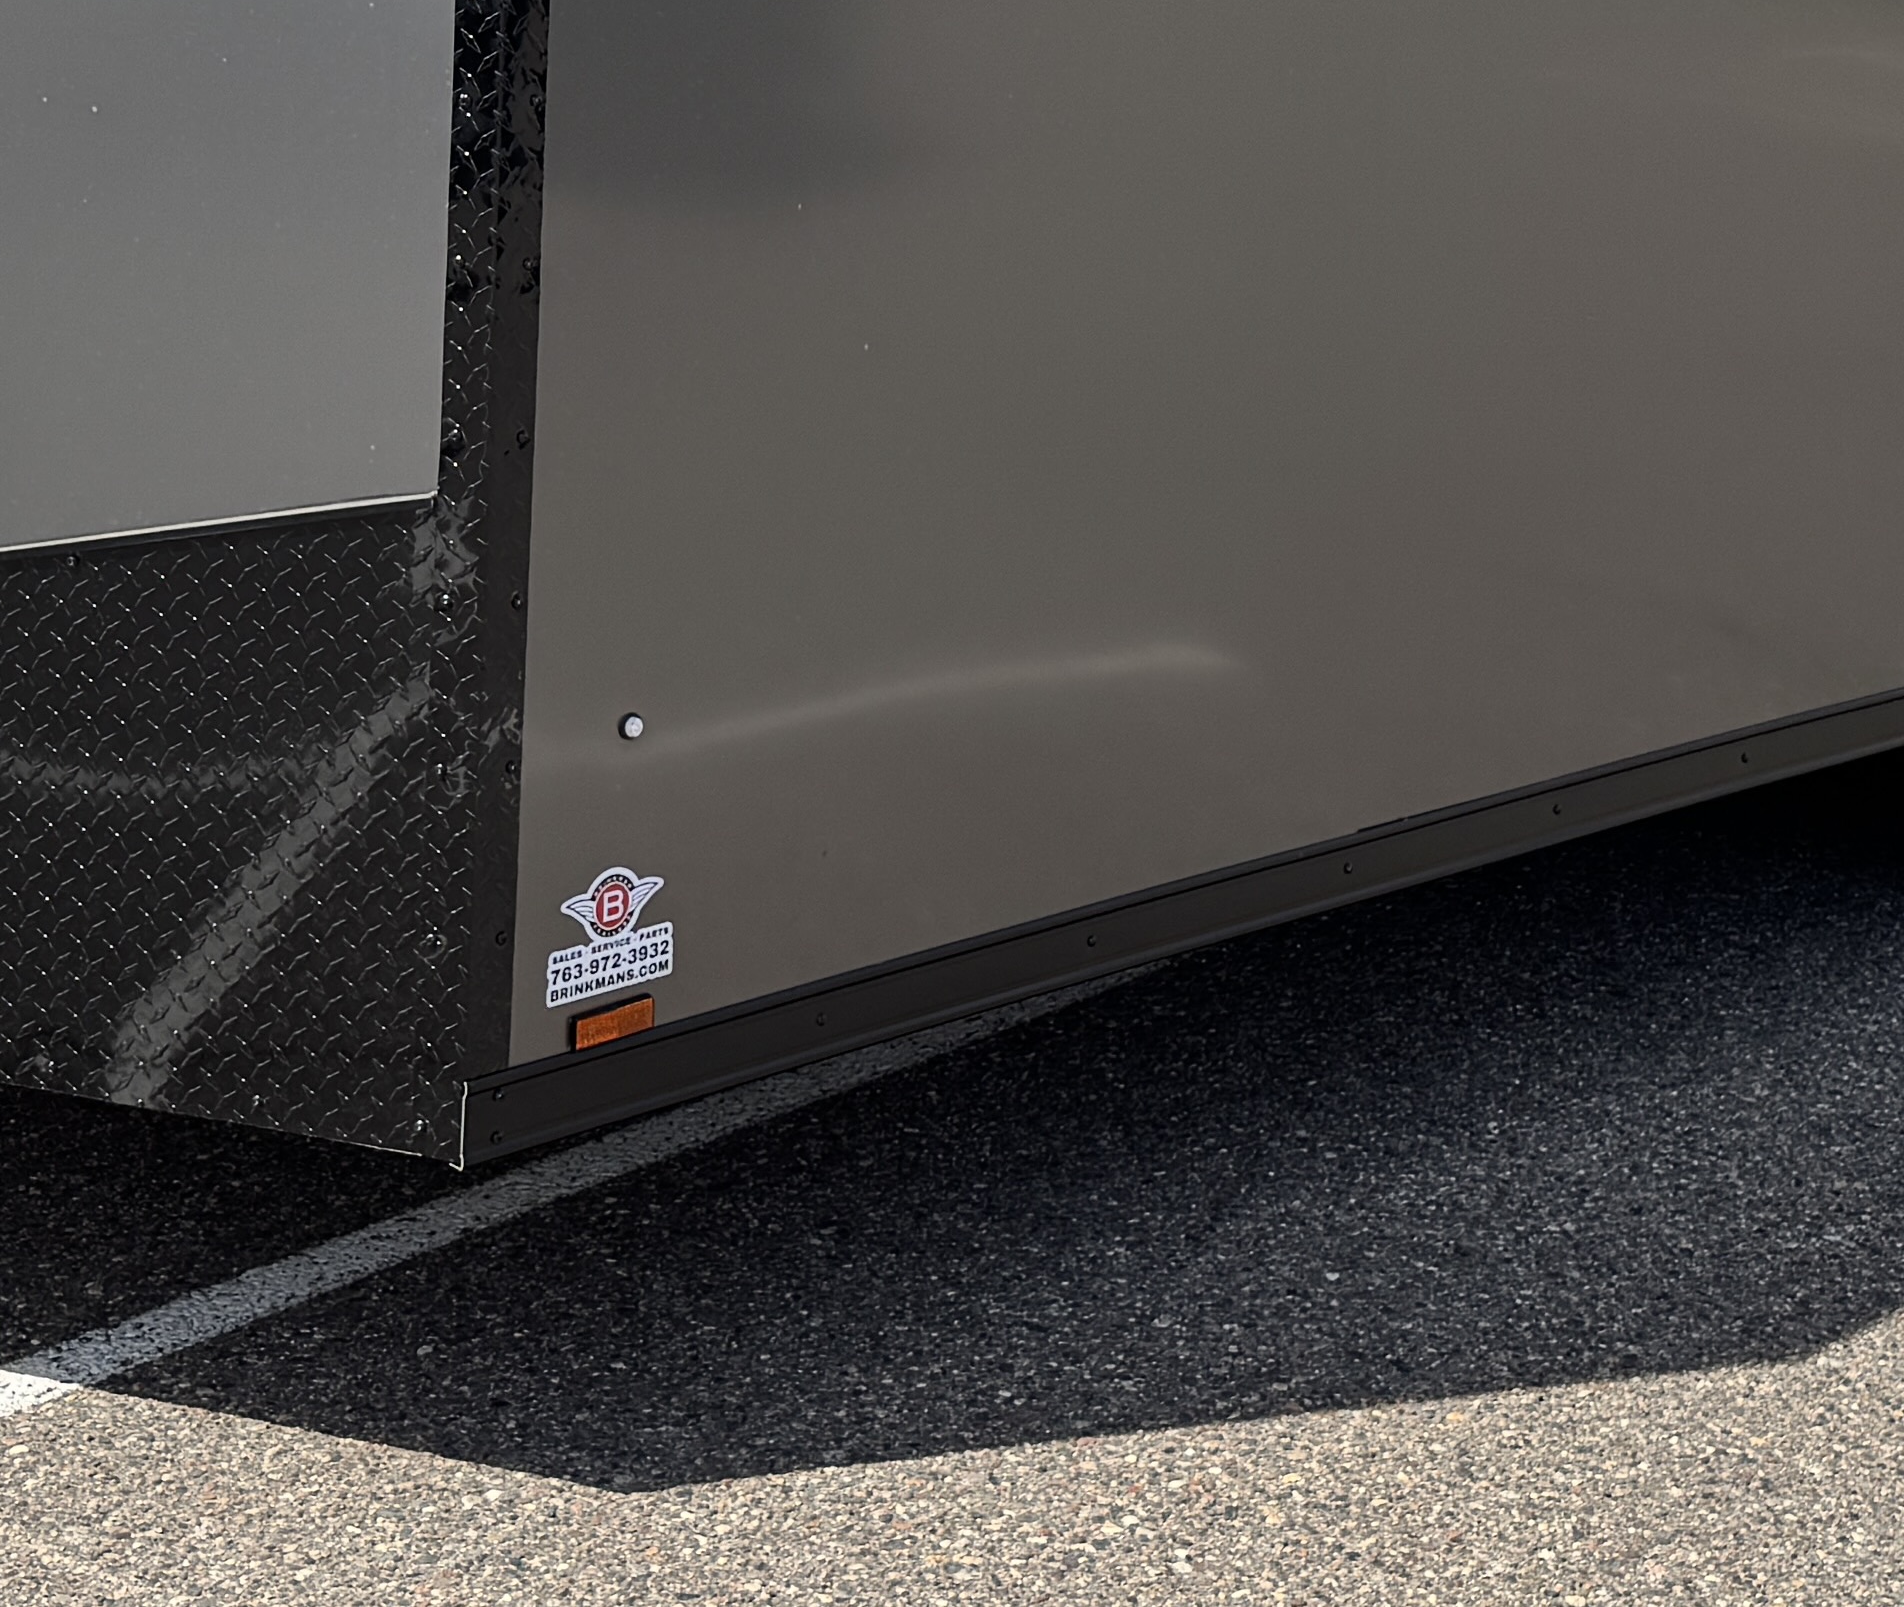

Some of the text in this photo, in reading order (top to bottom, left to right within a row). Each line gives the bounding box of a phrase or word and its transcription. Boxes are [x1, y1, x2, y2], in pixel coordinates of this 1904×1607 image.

[602, 889, 624, 923] B
[551, 940, 669, 985] 763-972-3932
[552, 927, 669, 965] SALES SERVICE PARTS
[550, 959, 669, 1002] BRINKMANS.COM
